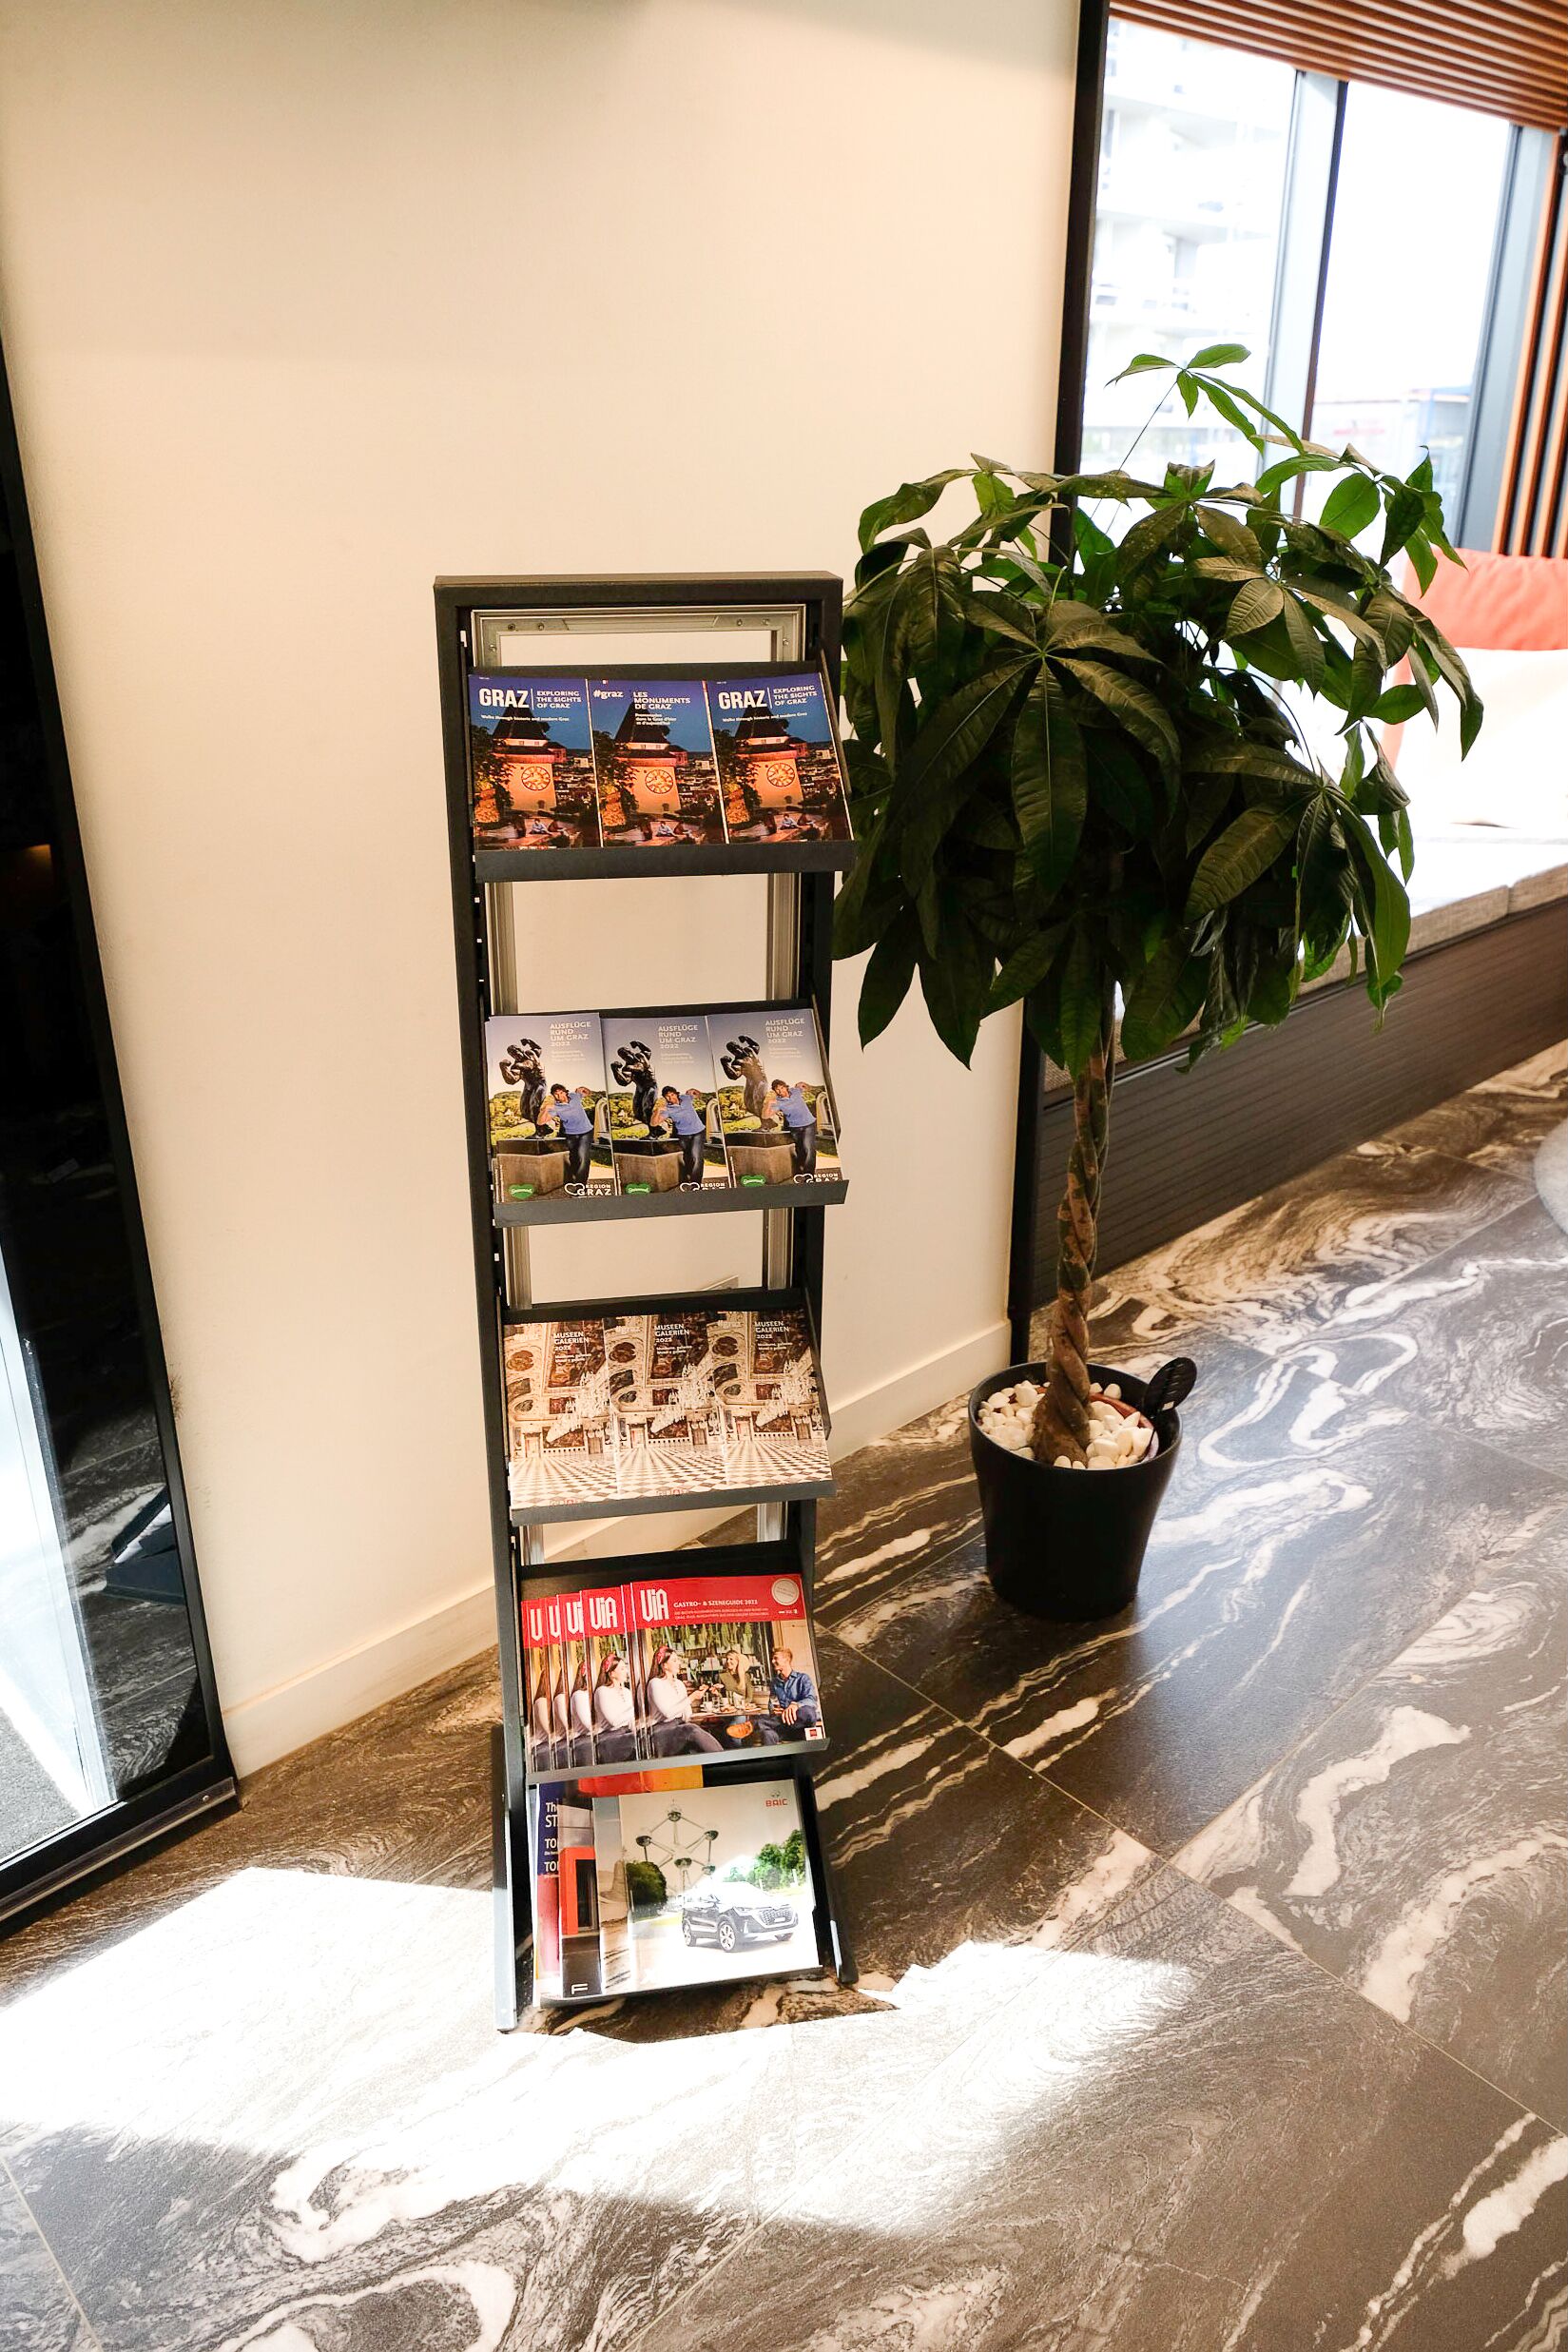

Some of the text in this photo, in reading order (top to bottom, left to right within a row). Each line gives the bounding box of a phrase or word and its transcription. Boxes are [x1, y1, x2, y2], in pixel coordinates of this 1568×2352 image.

[773, 685, 815, 694] EXPLORING
[478, 688, 530, 709] GRAZ
[593, 690, 624, 699] #graz
[790, 690, 818, 699] SIGHTS
[718, 690, 767, 709] GRAZ
[551, 1020, 591, 1029] AUSFLÜGE
[765, 1018, 805, 1026] AUSFLÜGE
[576, 1188, 612, 1196] GRAZ
[654, 1329, 690, 1337] GALERIEN
[765, 1798, 788, 1807] BAIC
